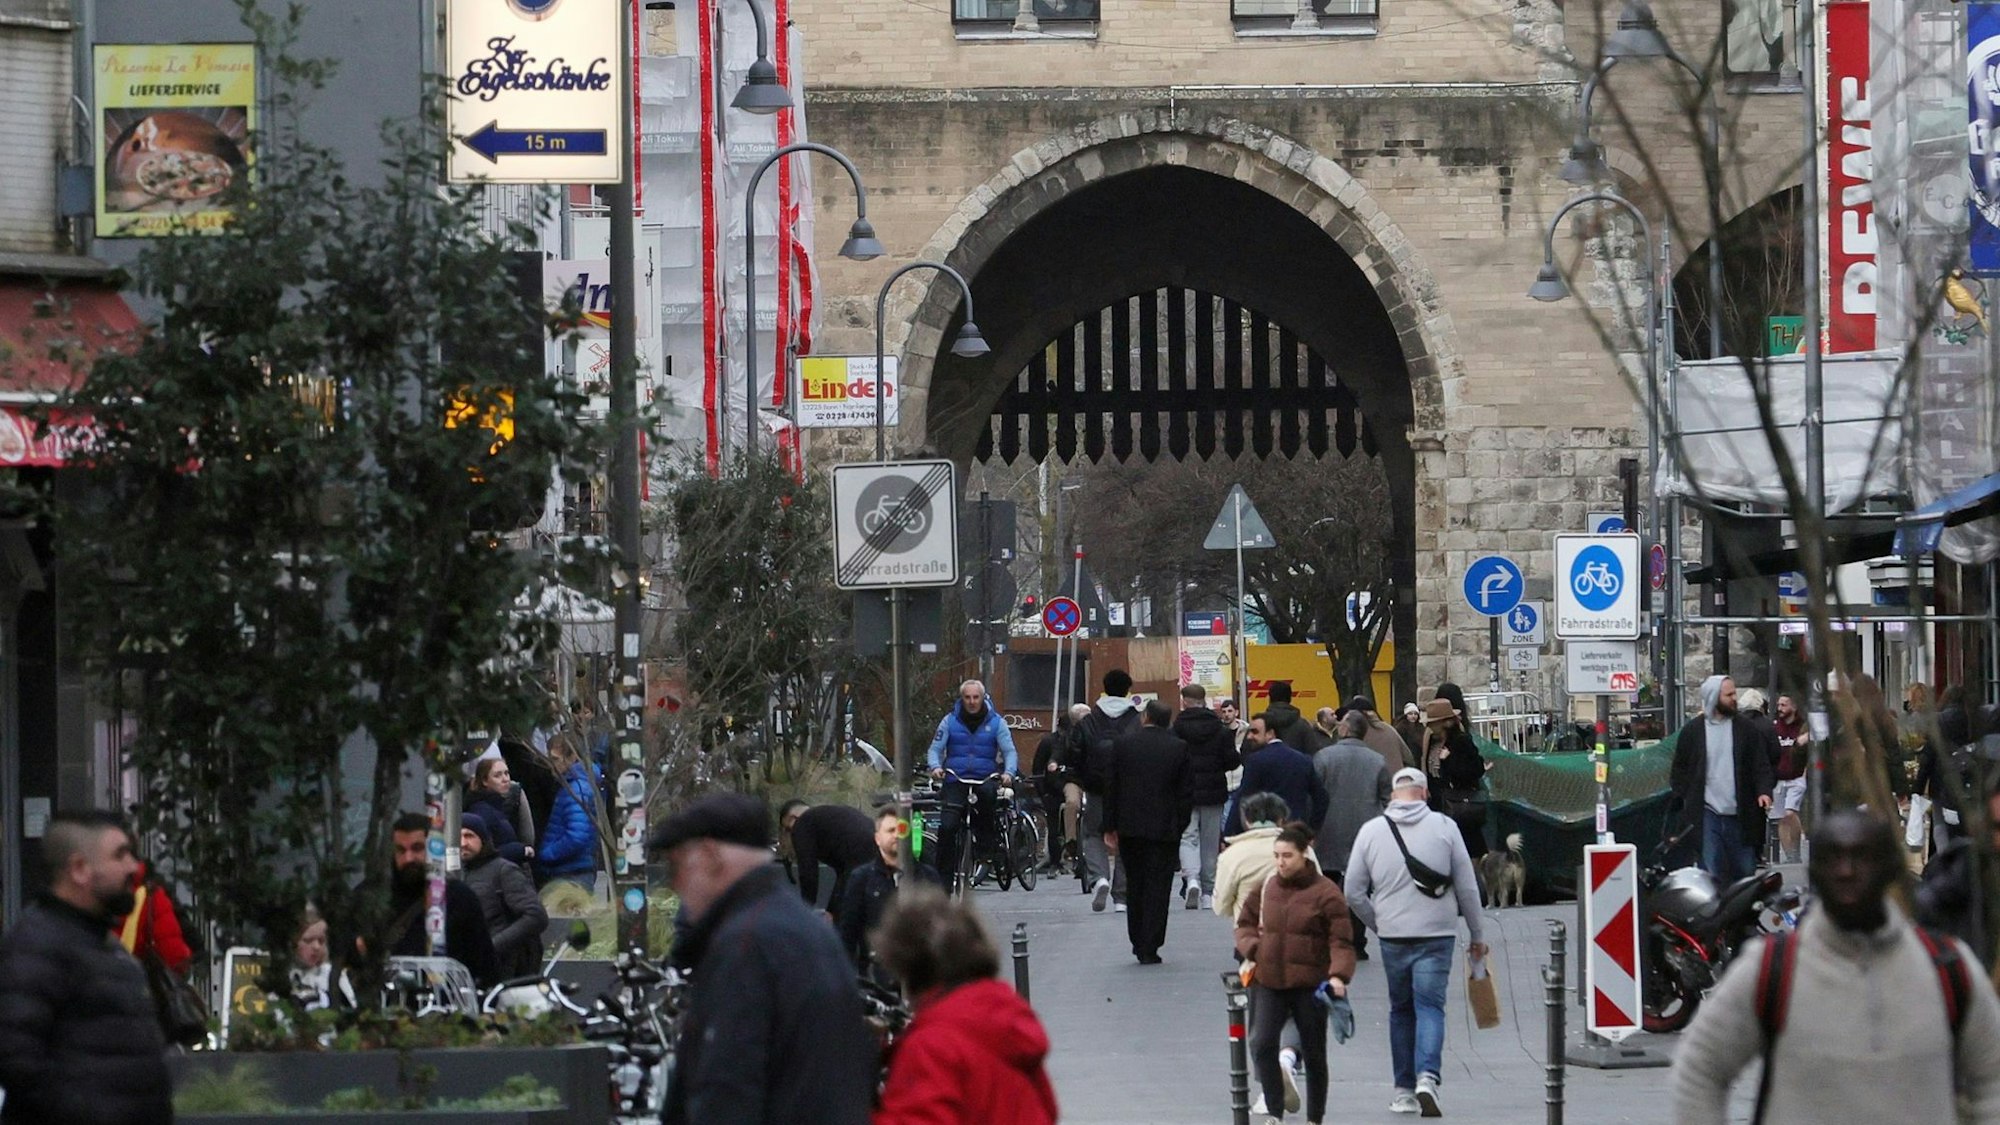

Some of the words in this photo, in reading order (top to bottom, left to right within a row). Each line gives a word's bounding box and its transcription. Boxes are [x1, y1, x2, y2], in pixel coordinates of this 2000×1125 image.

[129, 83, 221, 96] LIEFERSERVICE
[525, 135, 545, 150] 15
[550, 137, 566, 150] m
[802, 377, 893, 399] Linden
[1560, 617, 1634, 630] Fahrradstraße
[1512, 634, 1535, 643] ZONE
